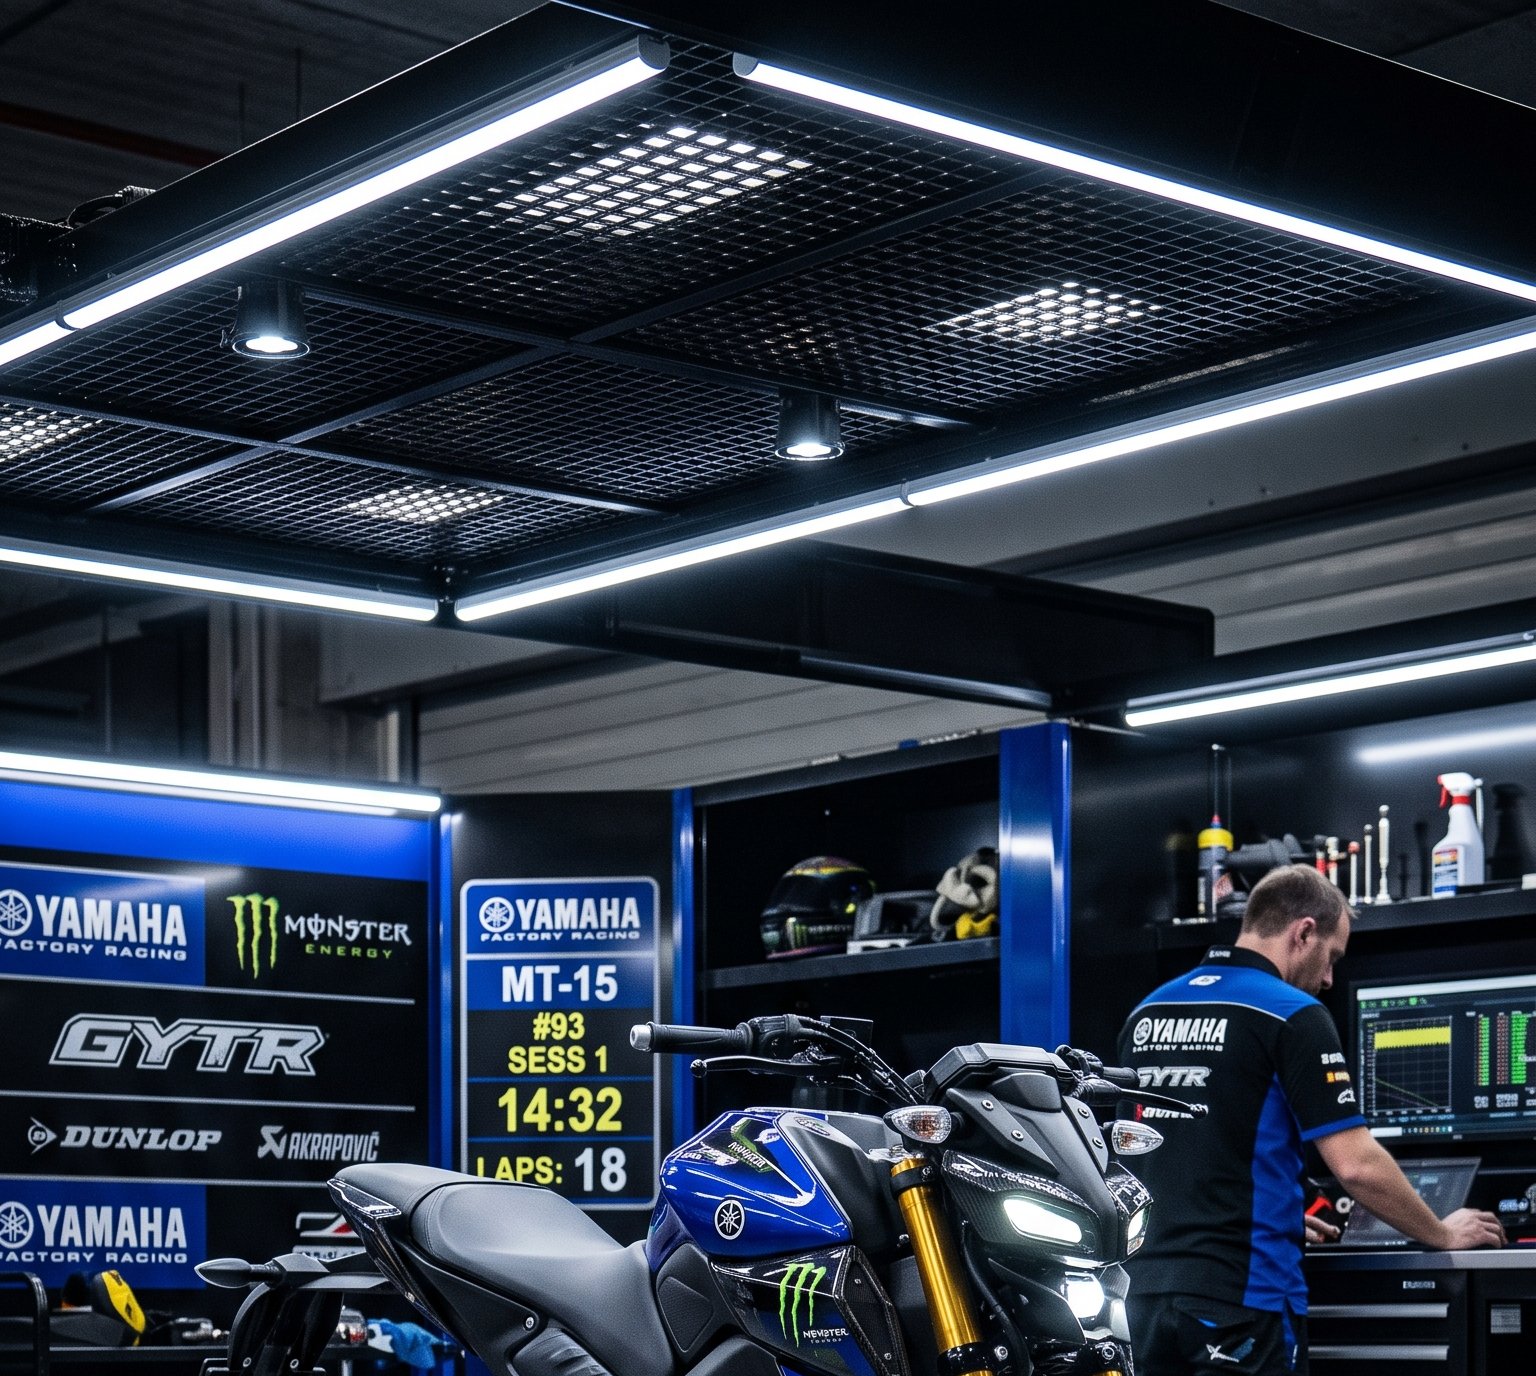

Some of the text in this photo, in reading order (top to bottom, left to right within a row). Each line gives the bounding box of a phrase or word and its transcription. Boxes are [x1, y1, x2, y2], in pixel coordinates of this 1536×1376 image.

[35, 894, 188, 947] YAMAHA
[515, 896, 641, 931] YAMAHA
[284, 913, 412, 946] MONSTER
[480, 930, 640, 942] FACTORY RACING
[104, 944, 187, 962] RACING
[305, 943, 392, 960] ENERGY
[502, 964, 618, 1003] MT-15
[533, 1012, 585, 1040] #93
[1151, 1018, 1228, 1044] YAMAHA
[48, 1013, 326, 1076] GYTR
[507, 1045, 607, 1074] SESS 1
[498, 1087, 622, 1133] 14:32
[60, 1125, 222, 1151] DUNLOP
[476, 1147, 628, 1192] LAPS: 18
[37, 1205, 187, 1248] YAMAHA
[105, 1251, 188, 1265] RACING
